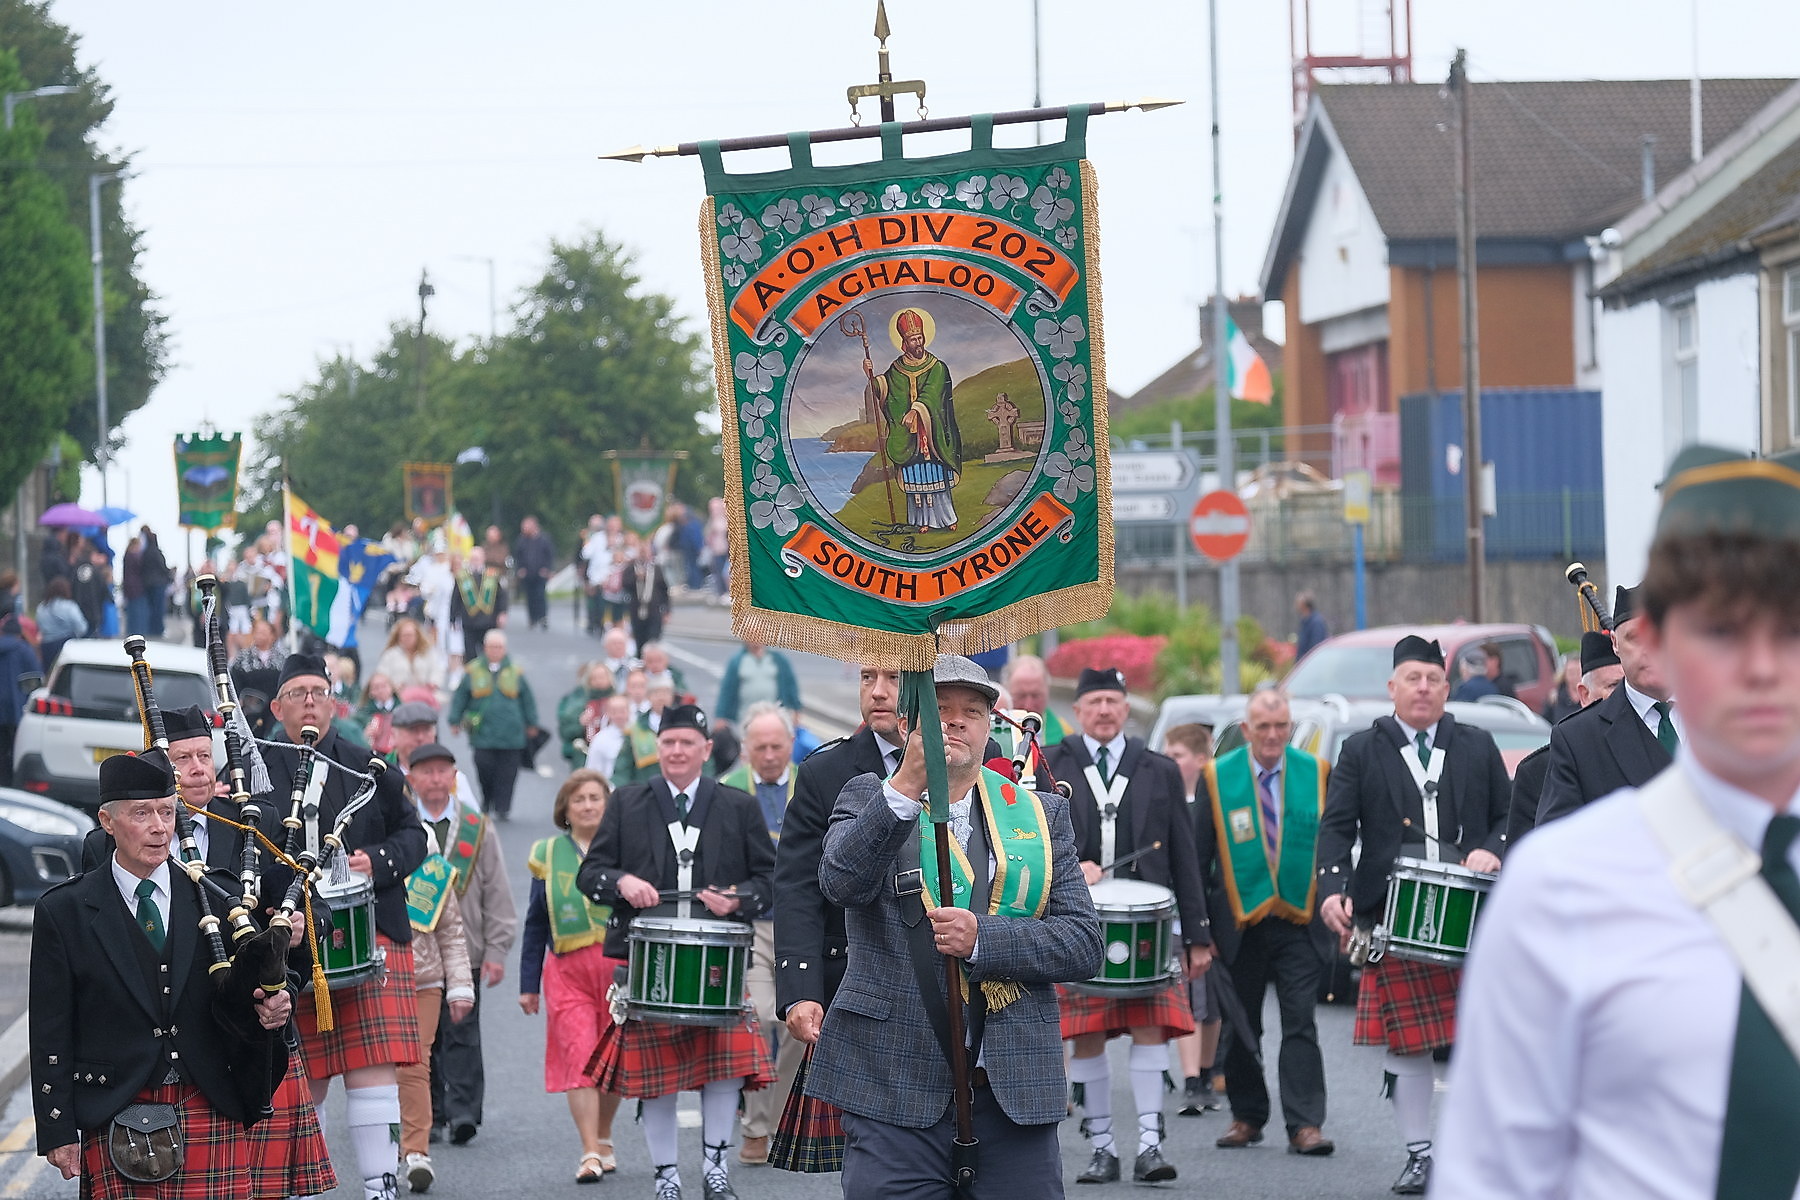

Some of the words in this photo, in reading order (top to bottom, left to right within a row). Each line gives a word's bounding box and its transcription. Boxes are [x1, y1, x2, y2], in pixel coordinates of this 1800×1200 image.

[878, 214, 956, 246] DIV
[971, 220, 1057, 279] 202
[815, 260, 996, 319] AGHALOO
[812, 541, 918, 601] SOUTH
[931, 510, 1049, 597] TYRONE
